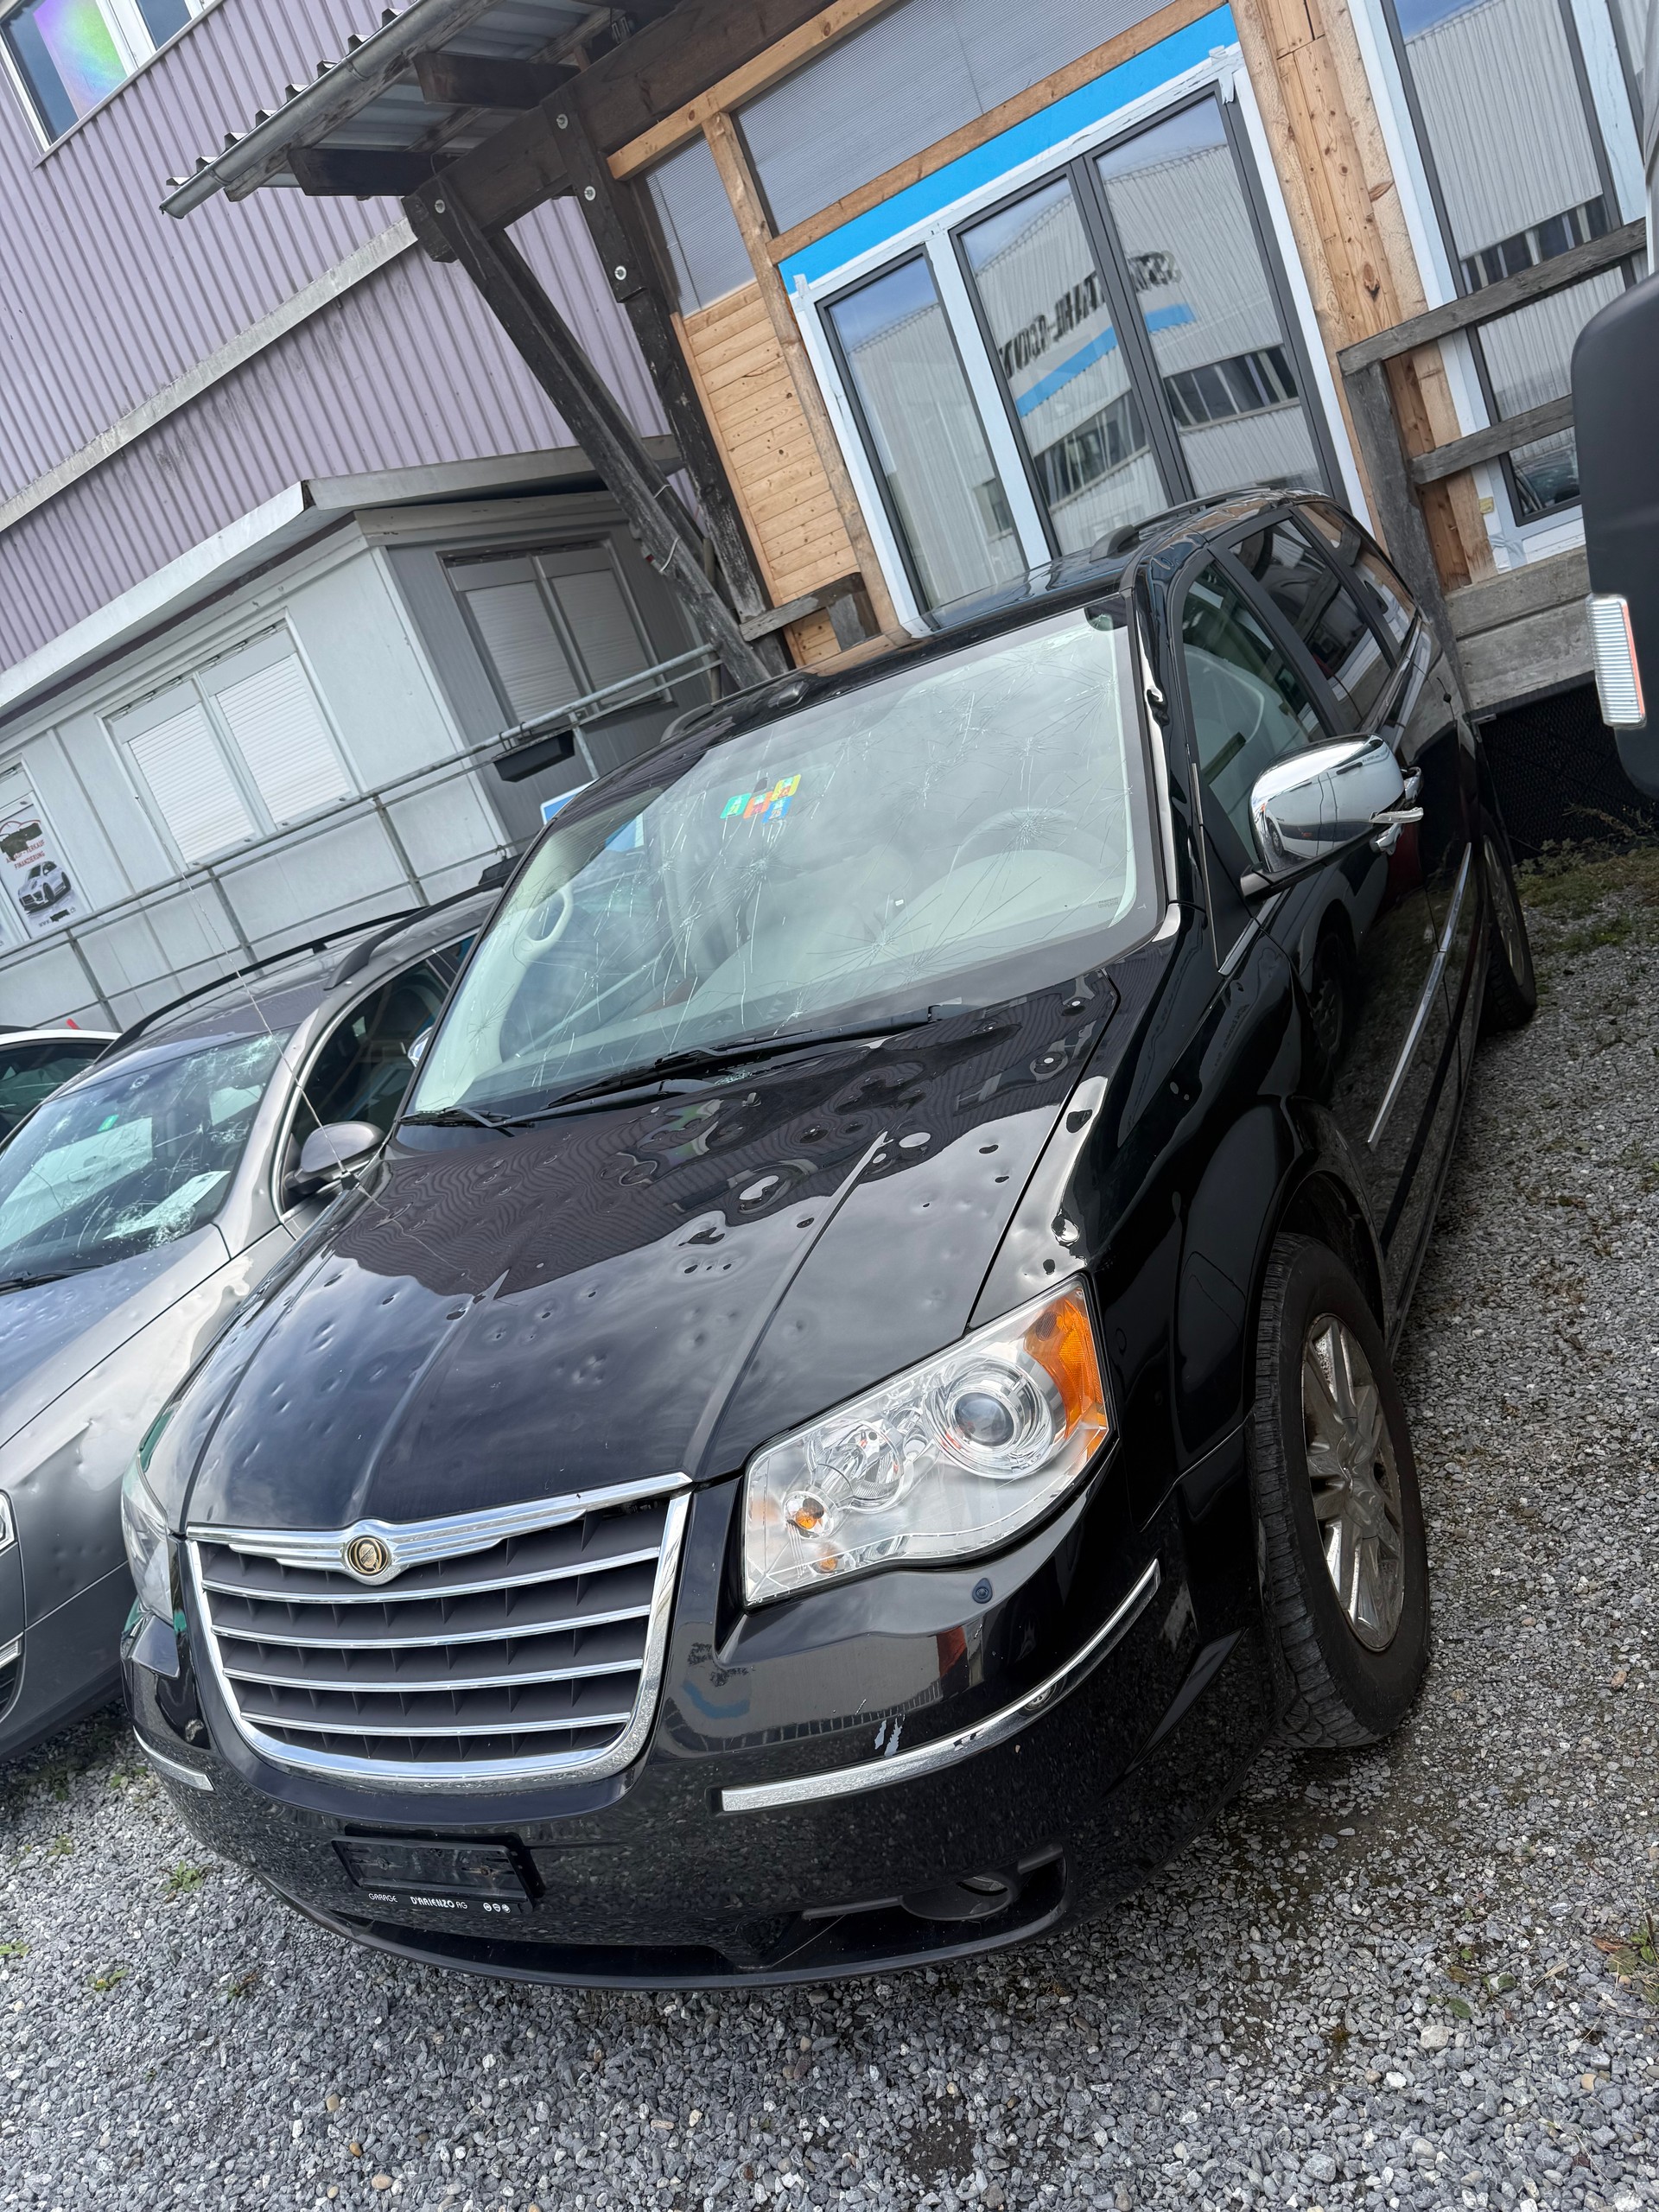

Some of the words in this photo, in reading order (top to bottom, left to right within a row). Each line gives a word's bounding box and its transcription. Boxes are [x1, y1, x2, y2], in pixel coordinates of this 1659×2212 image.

[15, 850, 45, 868] FINANZIERUNG
[368, 1892, 398, 1903] GARAGE
[410, 1896, 455, 1909] D'ARIENZO
[455, 1901, 468, 1910] AG
